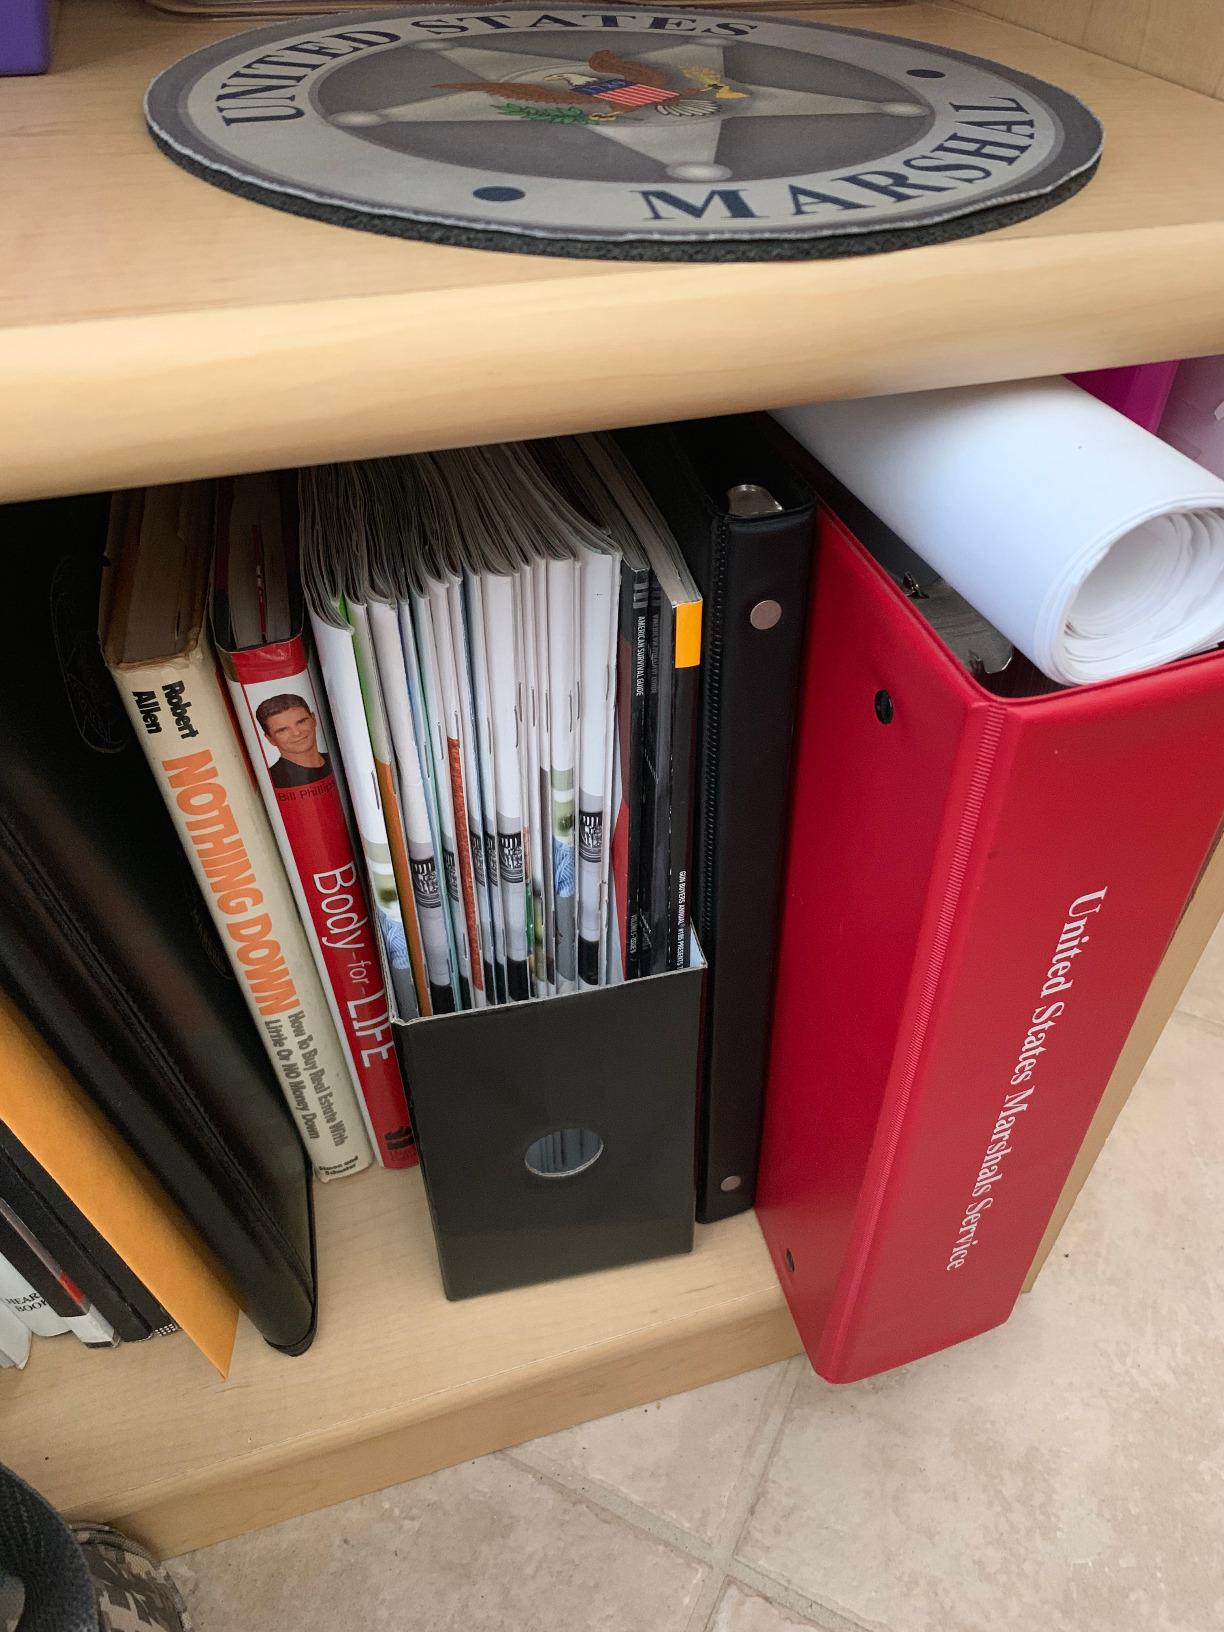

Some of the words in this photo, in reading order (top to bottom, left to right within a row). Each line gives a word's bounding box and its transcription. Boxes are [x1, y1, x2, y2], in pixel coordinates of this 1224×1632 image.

[215, 30, 401, 127] UNITED
[411, 14, 757, 36] STATES
[631, 96, 1036, 220] MARSHAL
[636, 616, 646, 648] AMERICAN
[636, 648, 645, 679] SURVIVAL
[635, 678, 644, 697] GUIDE
[131, 690, 163, 735] Allen
[161, 680, 199, 740] Robert
[278, 792, 297, 801] Bill
[161, 748, 264, 916] NOTHING
[226, 912, 302, 1016] DOWN
[1040, 886, 1109, 1000] United
[313, 860, 369, 949] Body
[347, 989, 396, 1068] LIFE
[264, 1019, 288, 1048] Little
[288, 1010, 306, 1038] How
[276, 1048, 293, 1061] Or
[297, 1034, 313, 1049] To
[1010, 1000, 1065, 1086] States
[282, 1062, 301, 1080] NO
[301, 1048, 318, 1071] Buy
[289, 1079, 311, 1112] Money
[309, 1068, 331, 1095] Real
[318, 1091, 338, 1123] Estate
[301, 1112, 320, 1140] Down
[328, 1119, 349, 1147] With
[971, 1084, 1036, 1197] Marshals
[946, 1196, 994, 1272] Service
